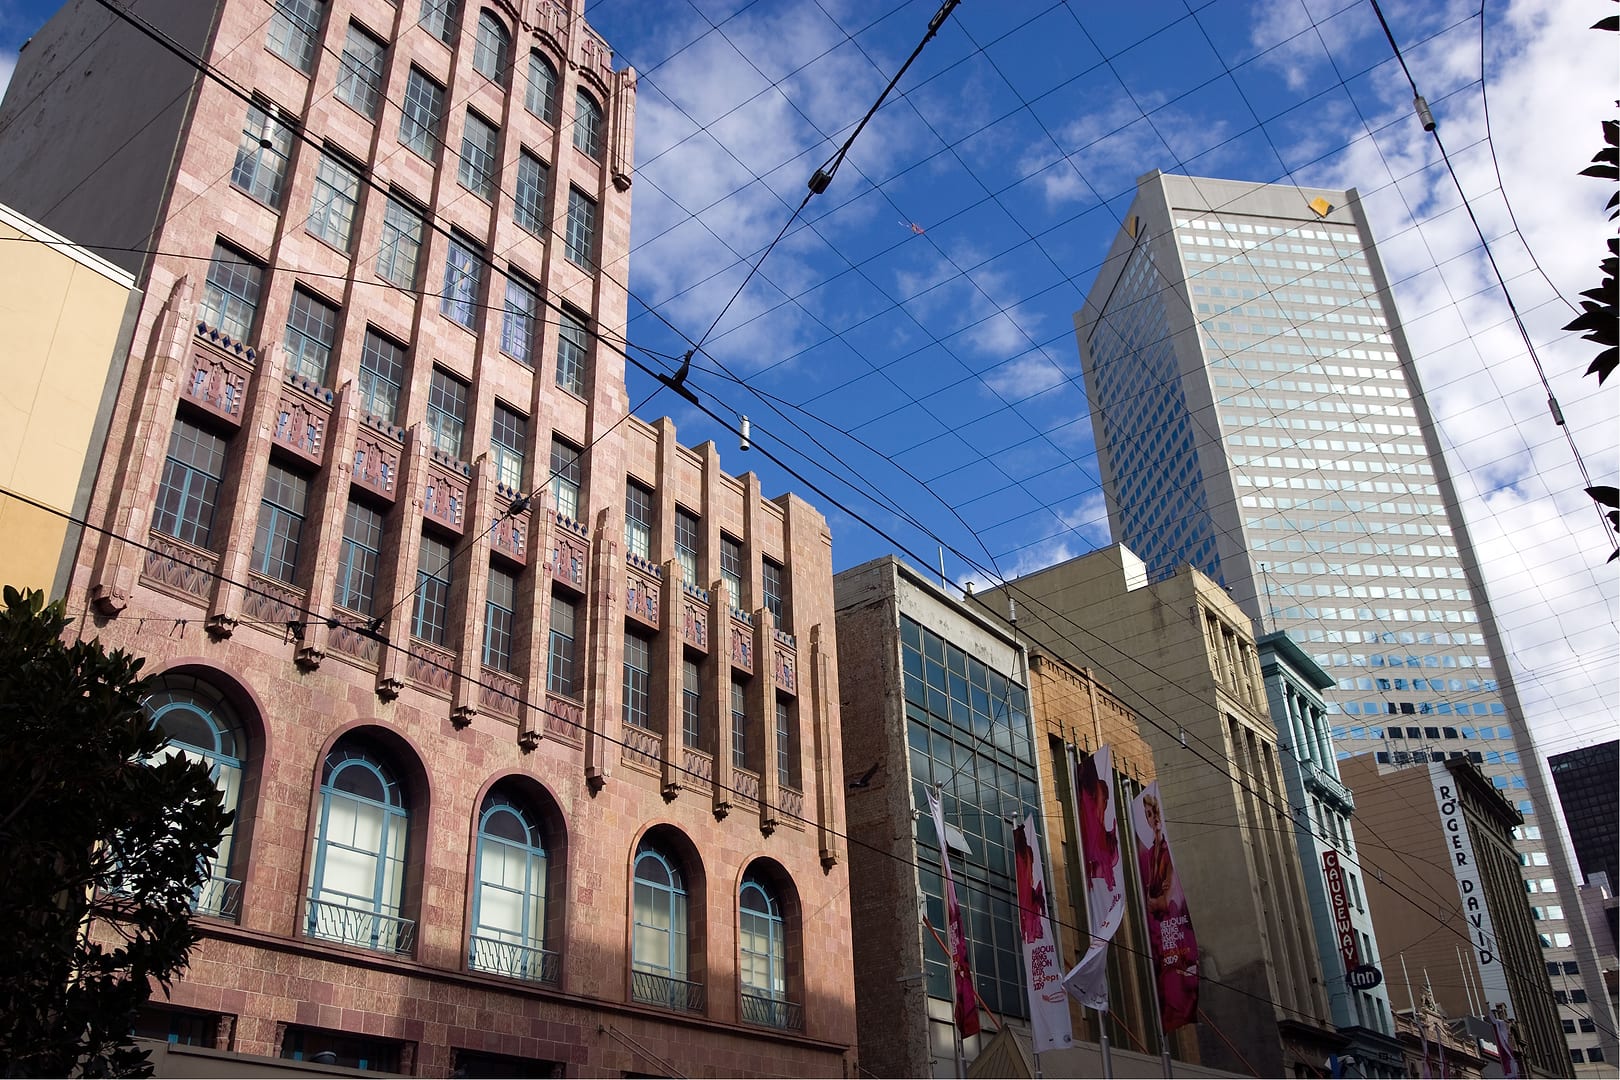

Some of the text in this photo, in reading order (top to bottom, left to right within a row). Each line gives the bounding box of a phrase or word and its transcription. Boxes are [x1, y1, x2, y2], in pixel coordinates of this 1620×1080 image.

[1326, 855, 1354, 960] CAUSEWAY
[1440, 786, 1493, 965] ROGER DAVID
[1350, 970, 1375, 986] Inn
